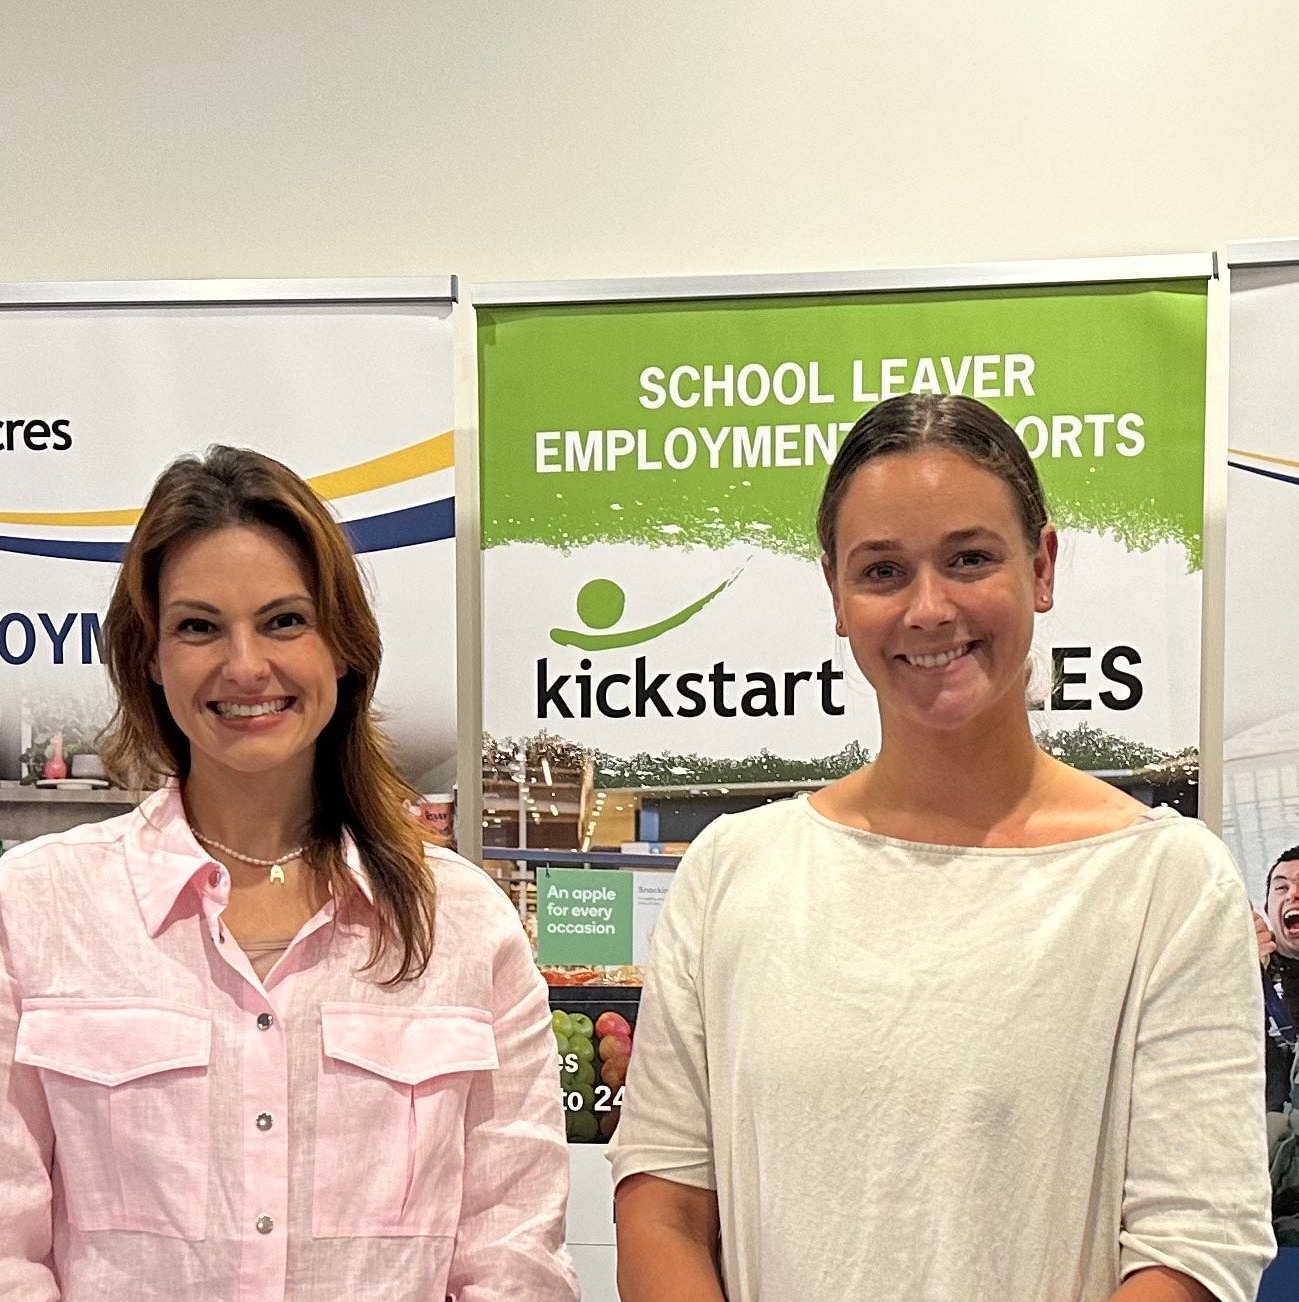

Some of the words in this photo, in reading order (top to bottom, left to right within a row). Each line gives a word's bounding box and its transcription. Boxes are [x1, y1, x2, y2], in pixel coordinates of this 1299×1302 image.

[638, 362, 835, 409] SCHOOL
[852, 352, 1035, 399] LEAVER
[534, 423, 858, 473] EMPLOYMEN
[535, 654, 845, 721] kickstart
[547, 885, 568, 899] An
[572, 887, 616, 903] apple
[547, 902, 569, 916] for
[572, 907, 613, 921] every
[547, 922, 616, 934] occasion
